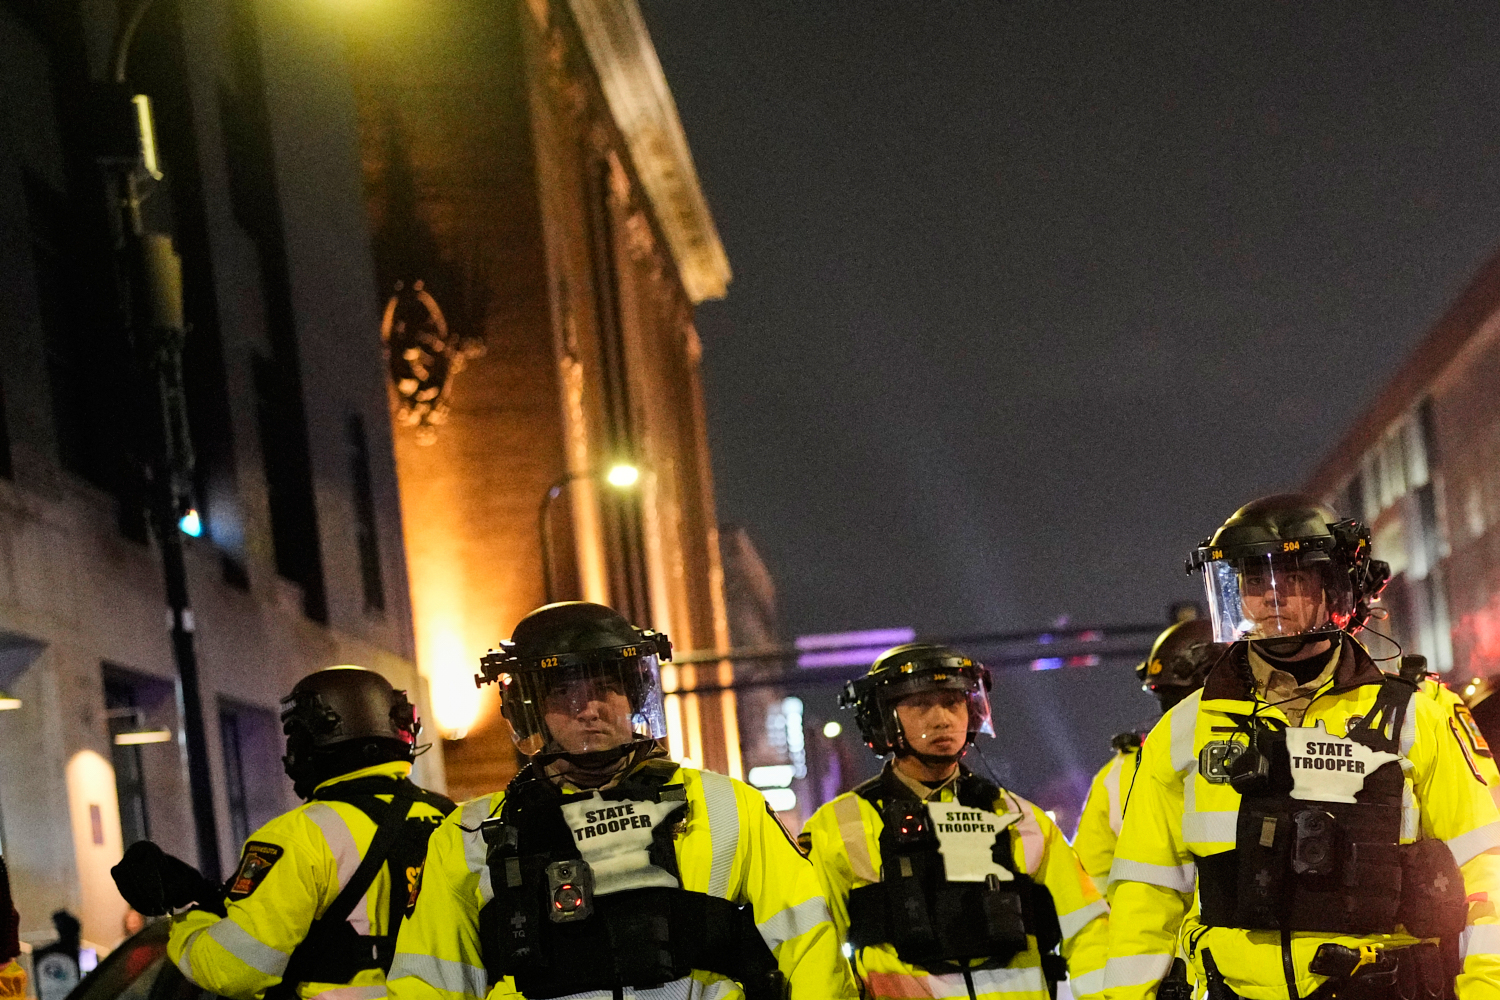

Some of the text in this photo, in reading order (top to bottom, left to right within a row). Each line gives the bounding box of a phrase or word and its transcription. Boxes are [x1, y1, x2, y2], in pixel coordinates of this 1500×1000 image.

[1283, 541, 1300, 552] 504
[1212, 550, 1223, 560] 504
[623, 647, 637, 657] 622
[541, 657, 558, 669] 622
[1306, 741, 1353, 757] STATE
[1292, 756, 1365, 775] TROOPER
[585, 803, 635, 824] STATE
[945, 811, 984, 822] STATE
[574, 814, 652, 841] TROOPER
[936, 823, 996, 833] TROOPER
[512, 929, 526, 939] TQ
